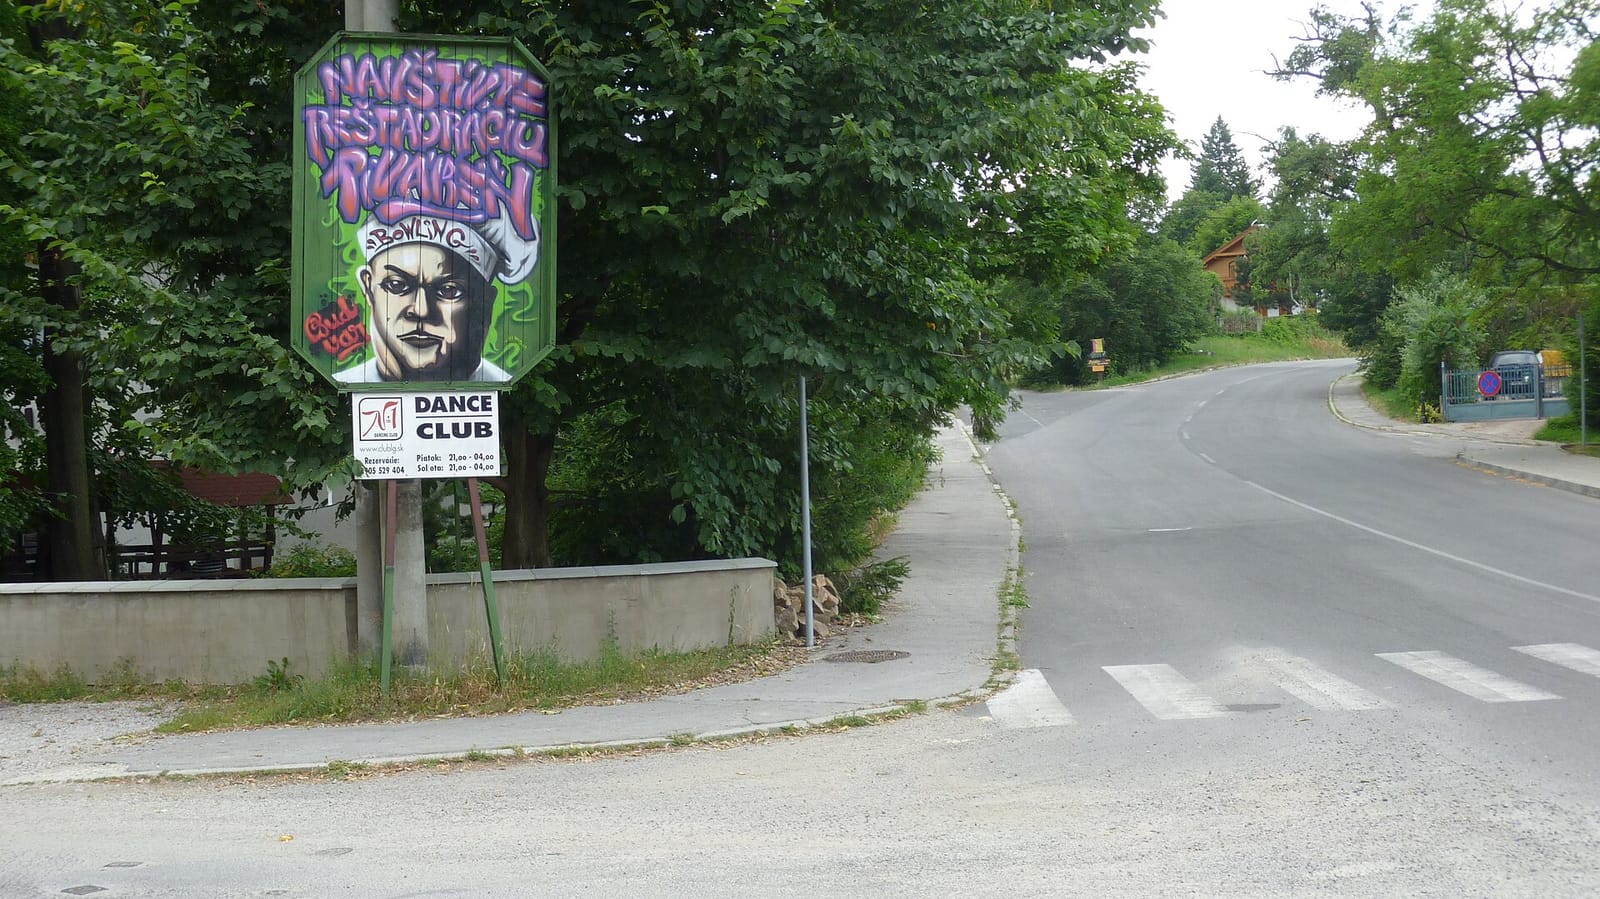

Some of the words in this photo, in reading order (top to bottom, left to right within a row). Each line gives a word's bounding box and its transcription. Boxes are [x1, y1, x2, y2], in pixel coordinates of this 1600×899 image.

[370, 217, 472, 252] BOWLING
[415, 396, 492, 413] DANCE
[416, 422, 493, 439] CLUB
[416, 453, 442, 462] Piatok:
[378, 466, 390, 474] 529
[392, 466, 404, 474] 404
